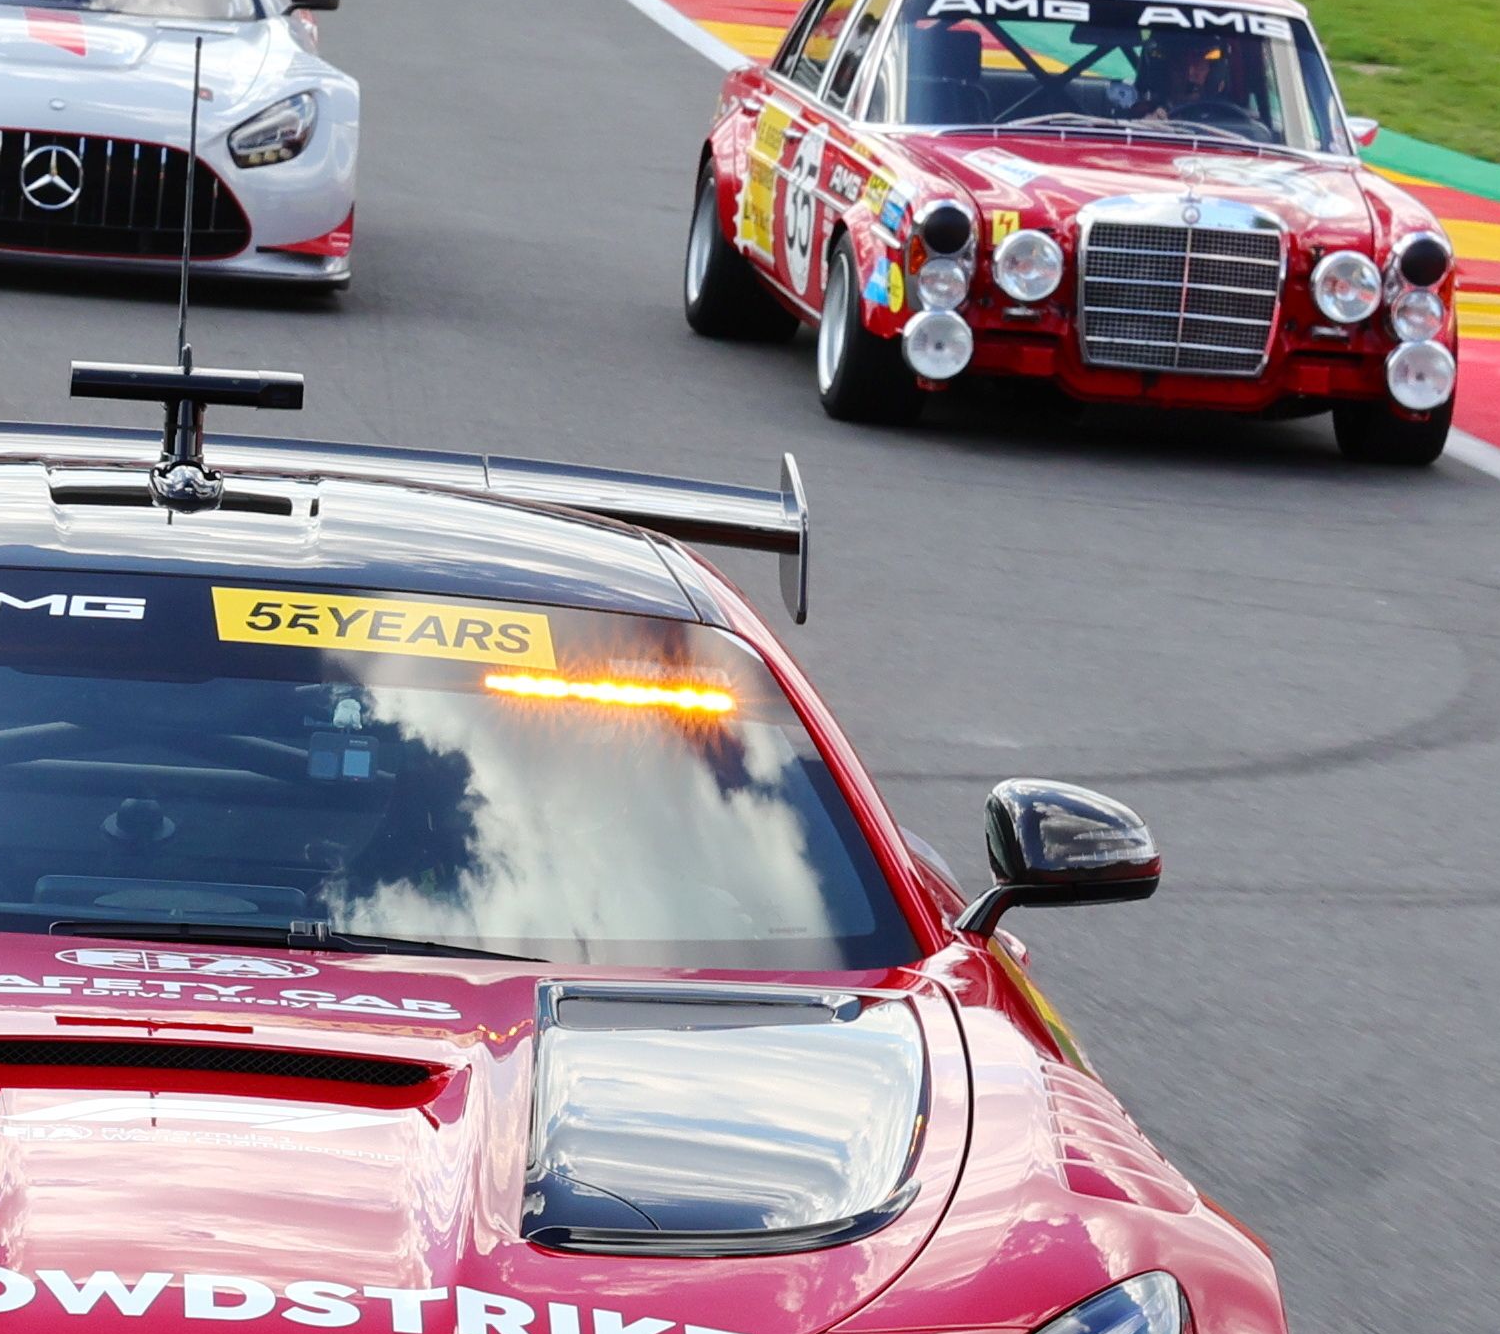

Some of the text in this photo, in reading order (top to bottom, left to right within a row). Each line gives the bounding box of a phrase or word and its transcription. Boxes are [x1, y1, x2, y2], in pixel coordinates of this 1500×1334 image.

[1138, 5, 1292, 41] AMG
[829, 163, 864, 203] AMG
[74, 949, 294, 978] FIA
[82, 988, 182, 999] Drive
[279, 989, 461, 1014] CAR
